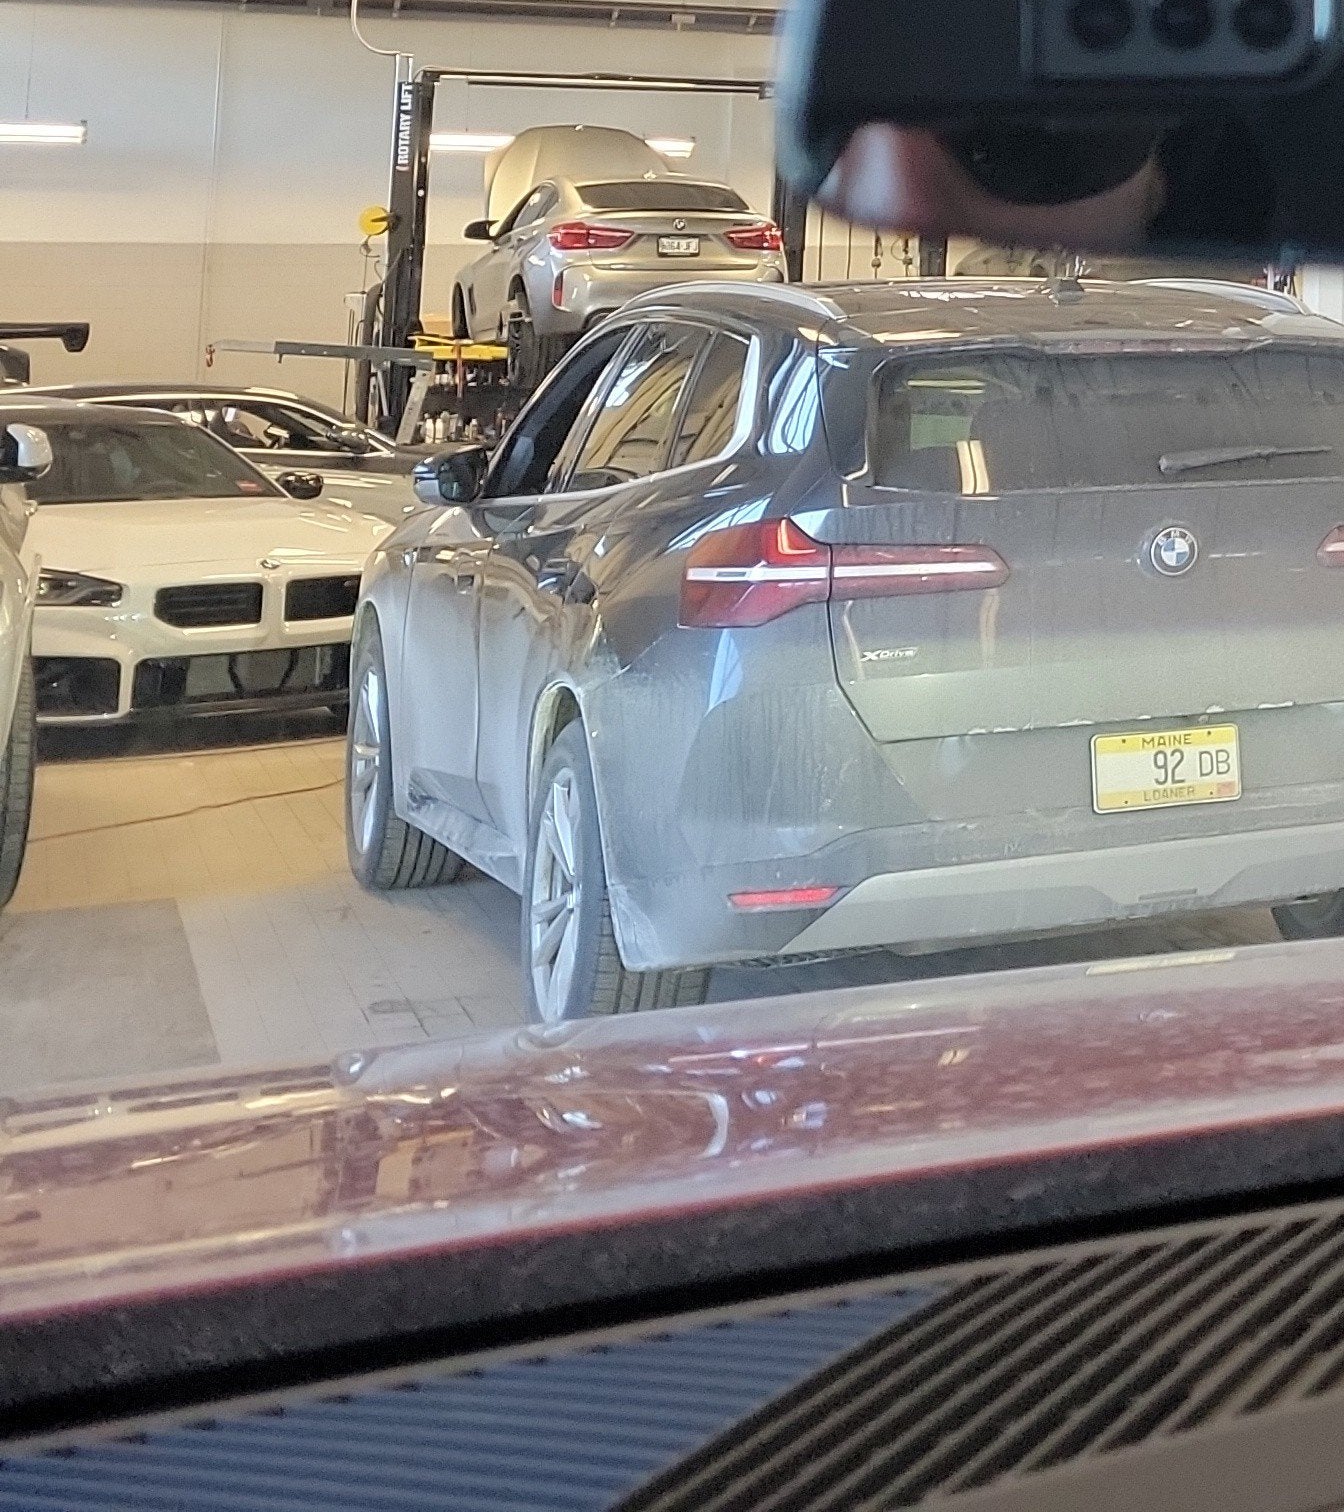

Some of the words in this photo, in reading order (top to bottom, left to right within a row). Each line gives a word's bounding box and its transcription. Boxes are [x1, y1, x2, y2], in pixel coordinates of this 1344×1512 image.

[400, 83, 414, 111] LIFT
[397, 112, 412, 165] ROTARY
[1142, 733, 1192, 749] MAINE
[1153, 748, 1186, 785] 92
[1199, 749, 1231, 777] DB
[1144, 787, 1195, 802] LOANER
